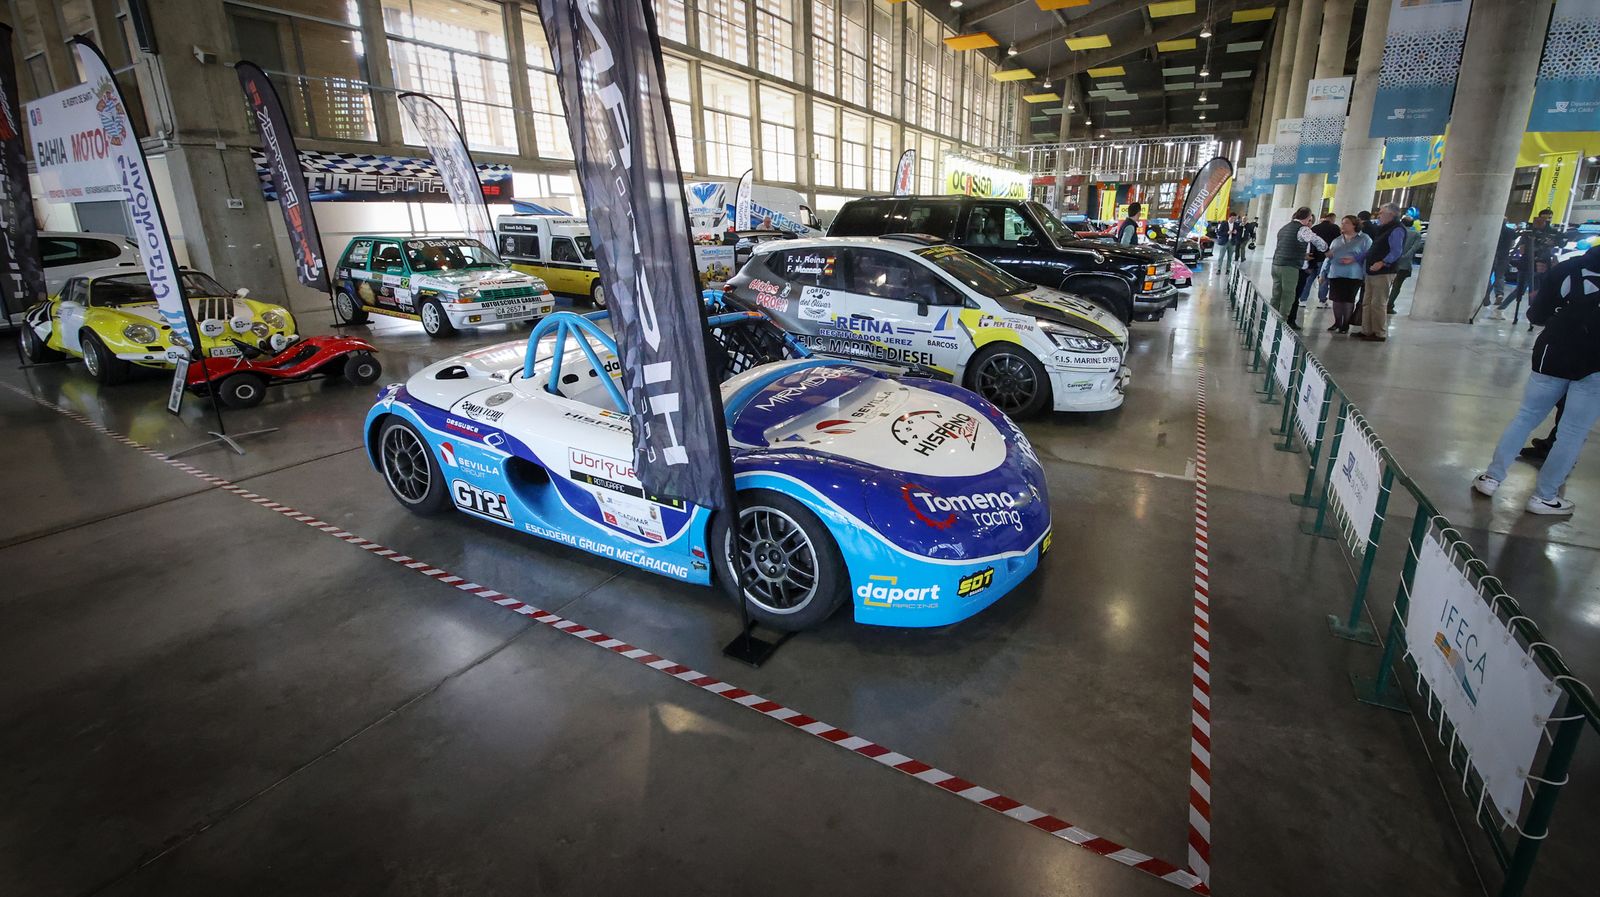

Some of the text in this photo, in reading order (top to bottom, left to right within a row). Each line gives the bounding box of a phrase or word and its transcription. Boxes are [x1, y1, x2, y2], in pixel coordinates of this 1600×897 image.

[1311, 85, 1346, 95] IFECA
[38, 137, 68, 167] BAHIA
[1188, 189, 1210, 216] PUERTO
[481, 299, 521, 308] AUTOESCUELA
[819, 329, 912, 346] RECTIFICADOS JEREZ
[836, 316, 893, 335] REINA
[830, 340, 884, 359] MARINE
[887, 348, 937, 366] DIESEL
[928, 340, 958, 349] BARCOSS
[852, 390, 894, 417] SEVILLA
[914, 412, 972, 456] HISPANO
[458, 457, 499, 475] SEVILLA
[460, 465, 485, 478] CIRCUIT
[454, 480, 512, 520] GT2i
[913, 489, 1015, 513] Tomeno
[972, 507, 1024, 532] racing
[526, 522, 576, 546] ESCUDERIA
[579, 538, 614, 556] GRUPO
[616, 549, 688, 578] MECARACING
[856, 582, 942, 603] dapart
[958, 567, 994, 596] SDT
[1441, 599, 1488, 684] IFECA
